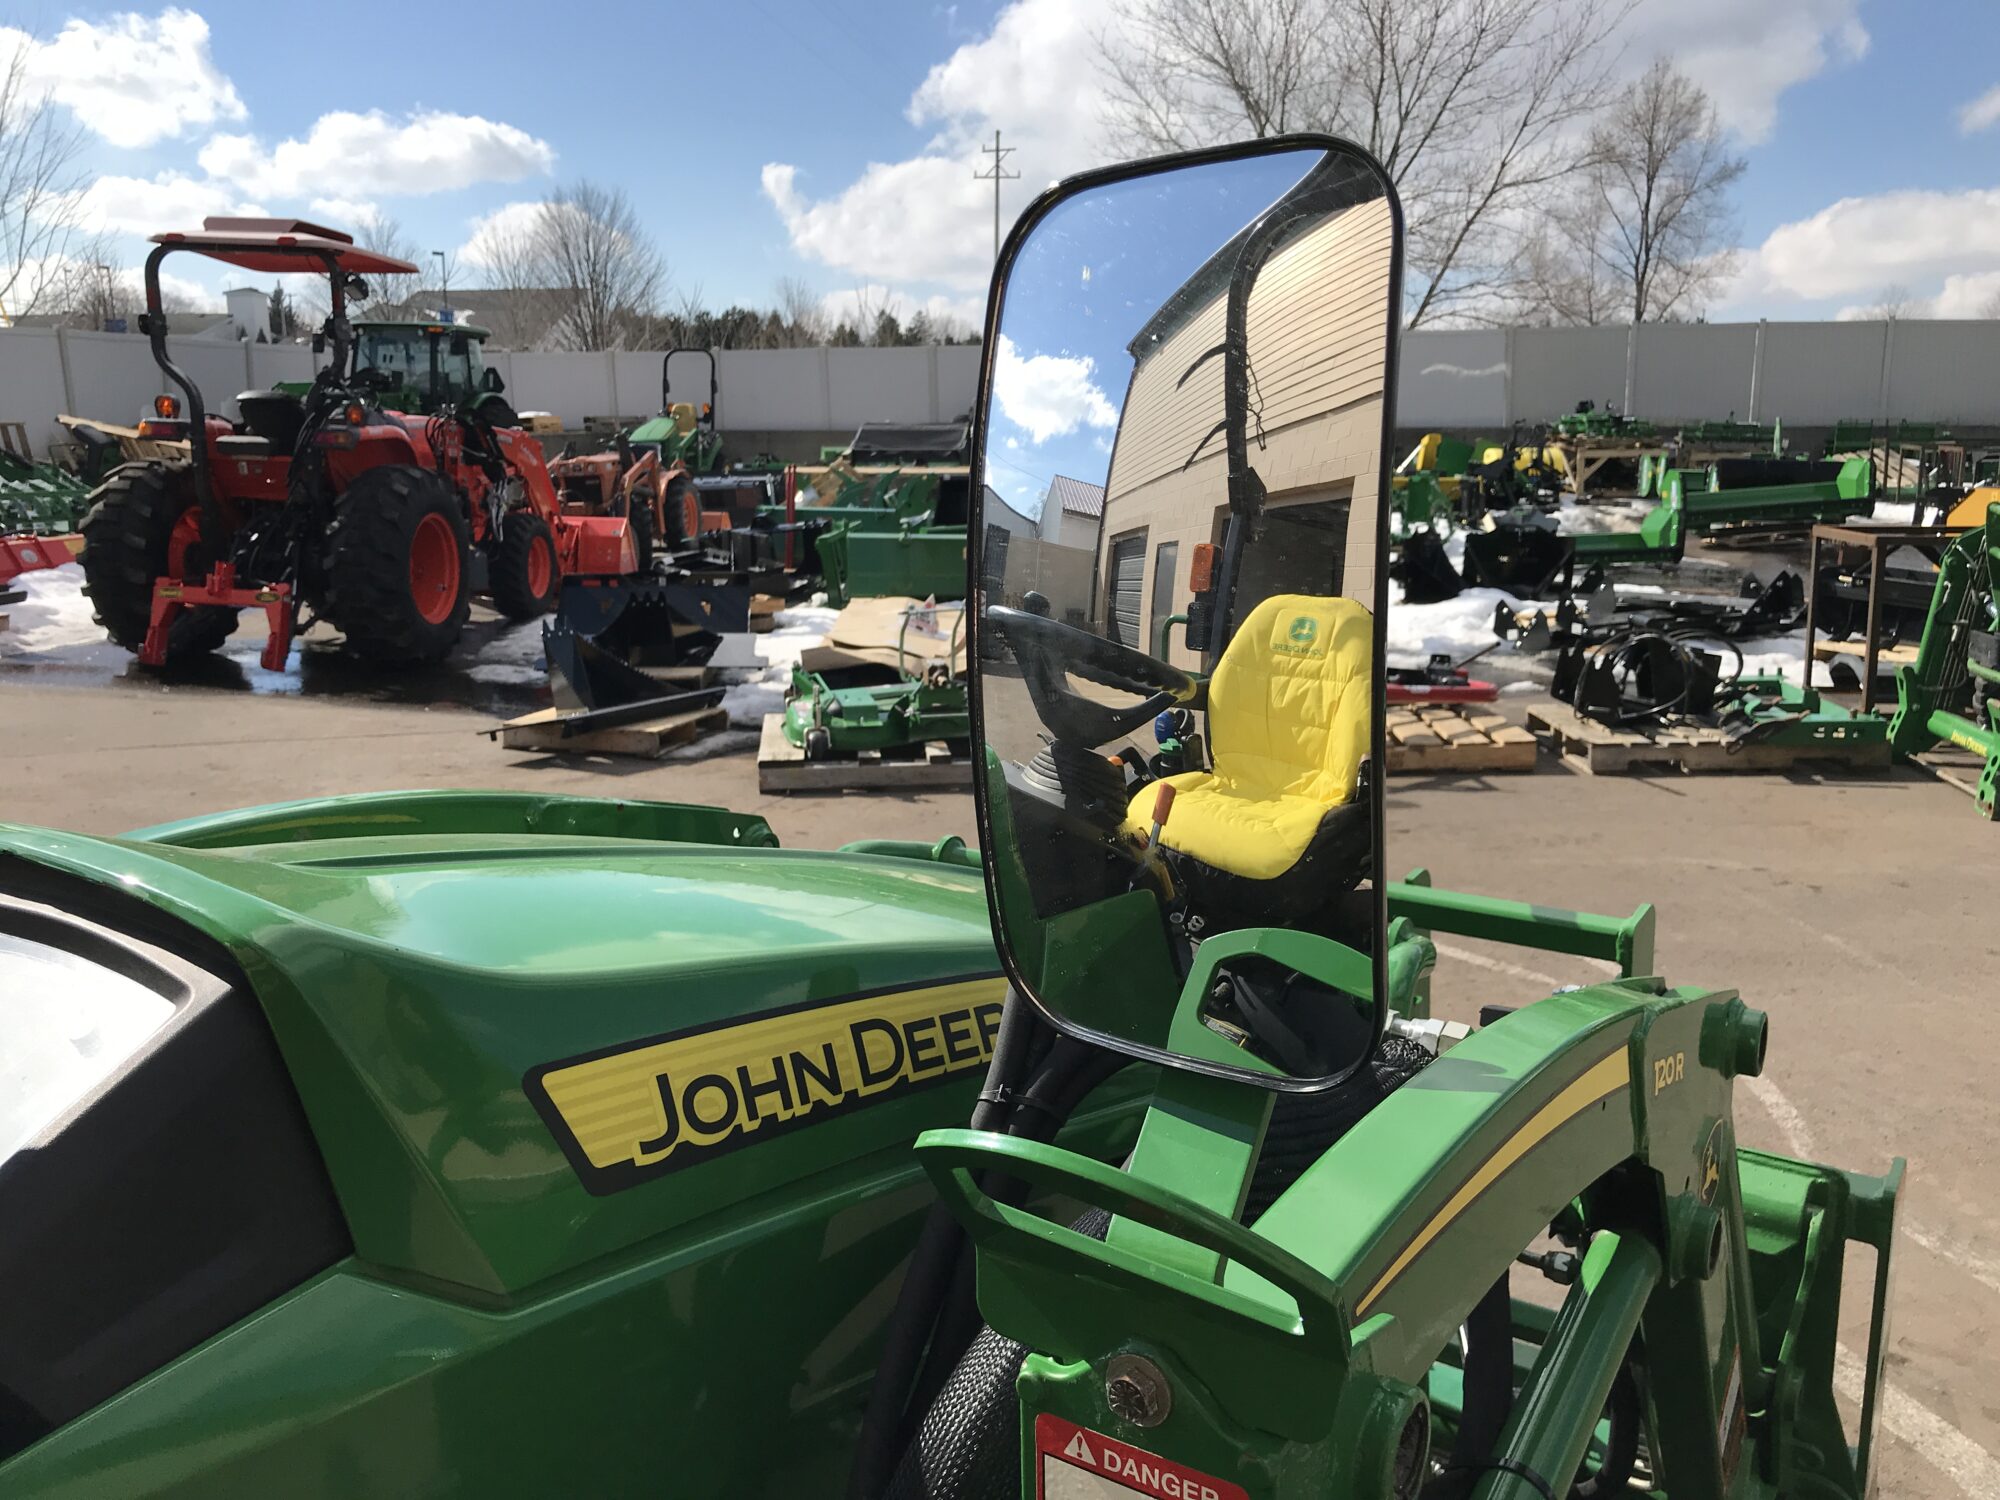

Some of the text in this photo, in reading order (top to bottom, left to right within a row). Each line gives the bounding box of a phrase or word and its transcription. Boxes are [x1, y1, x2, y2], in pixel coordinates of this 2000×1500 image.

[638, 1002, 1004, 1156] JOHN DEER
[1103, 1448, 1220, 1500] DANGER
